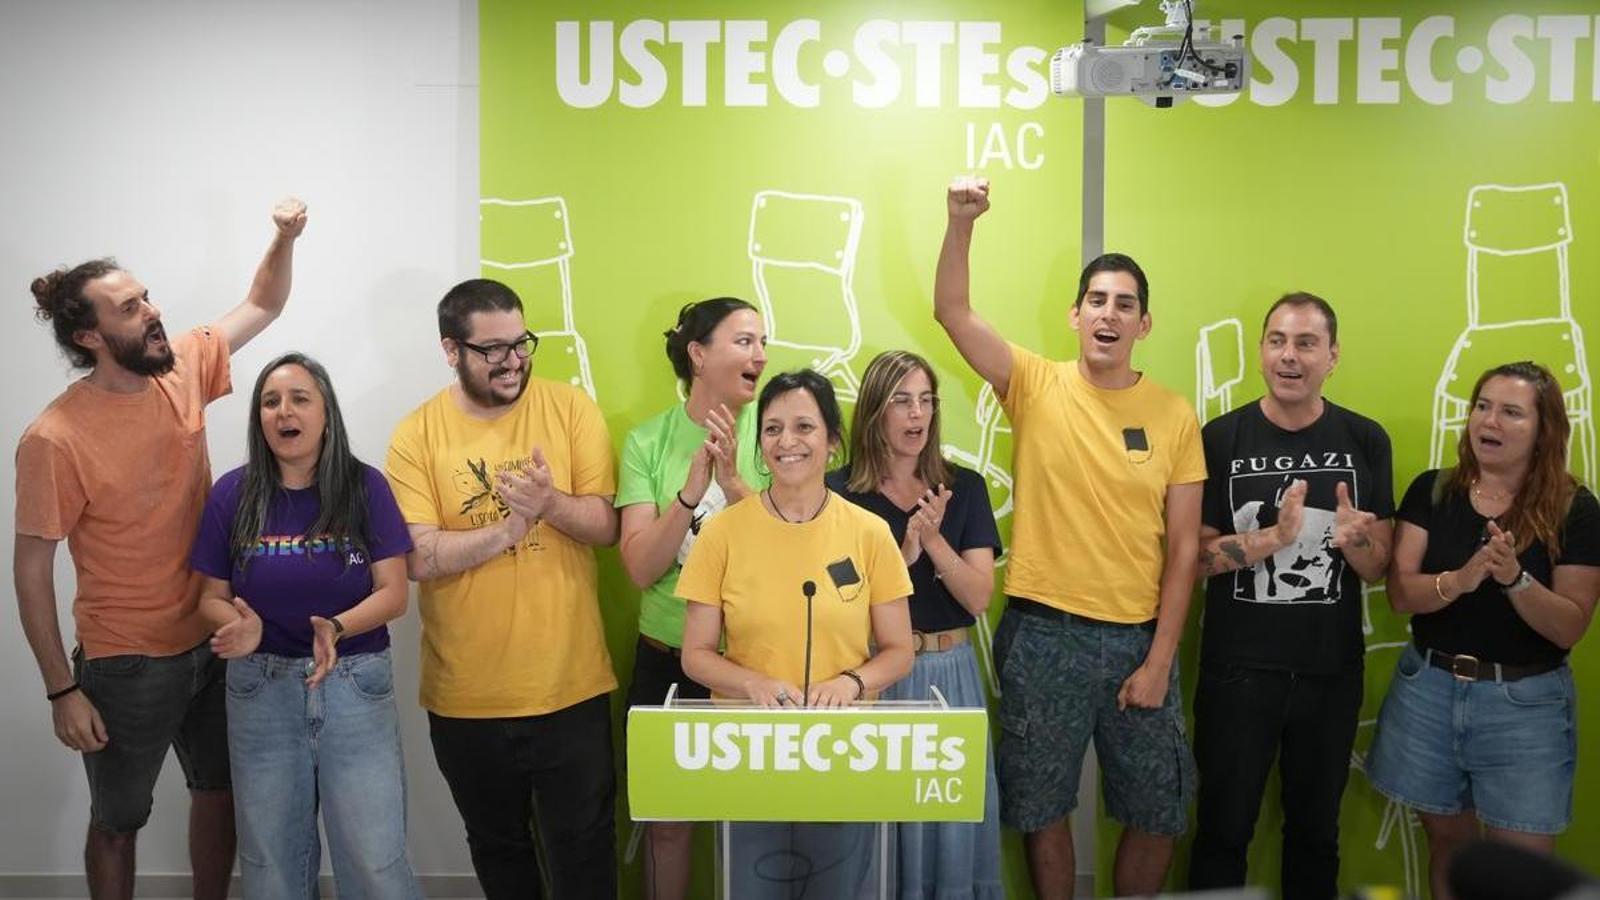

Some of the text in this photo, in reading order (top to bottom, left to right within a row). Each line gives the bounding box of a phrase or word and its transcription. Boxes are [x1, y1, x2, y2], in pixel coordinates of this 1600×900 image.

[966, 122, 1045, 170] IAC
[1230, 452, 1354, 474] FUGAZI
[915, 777, 963, 804] IAC
